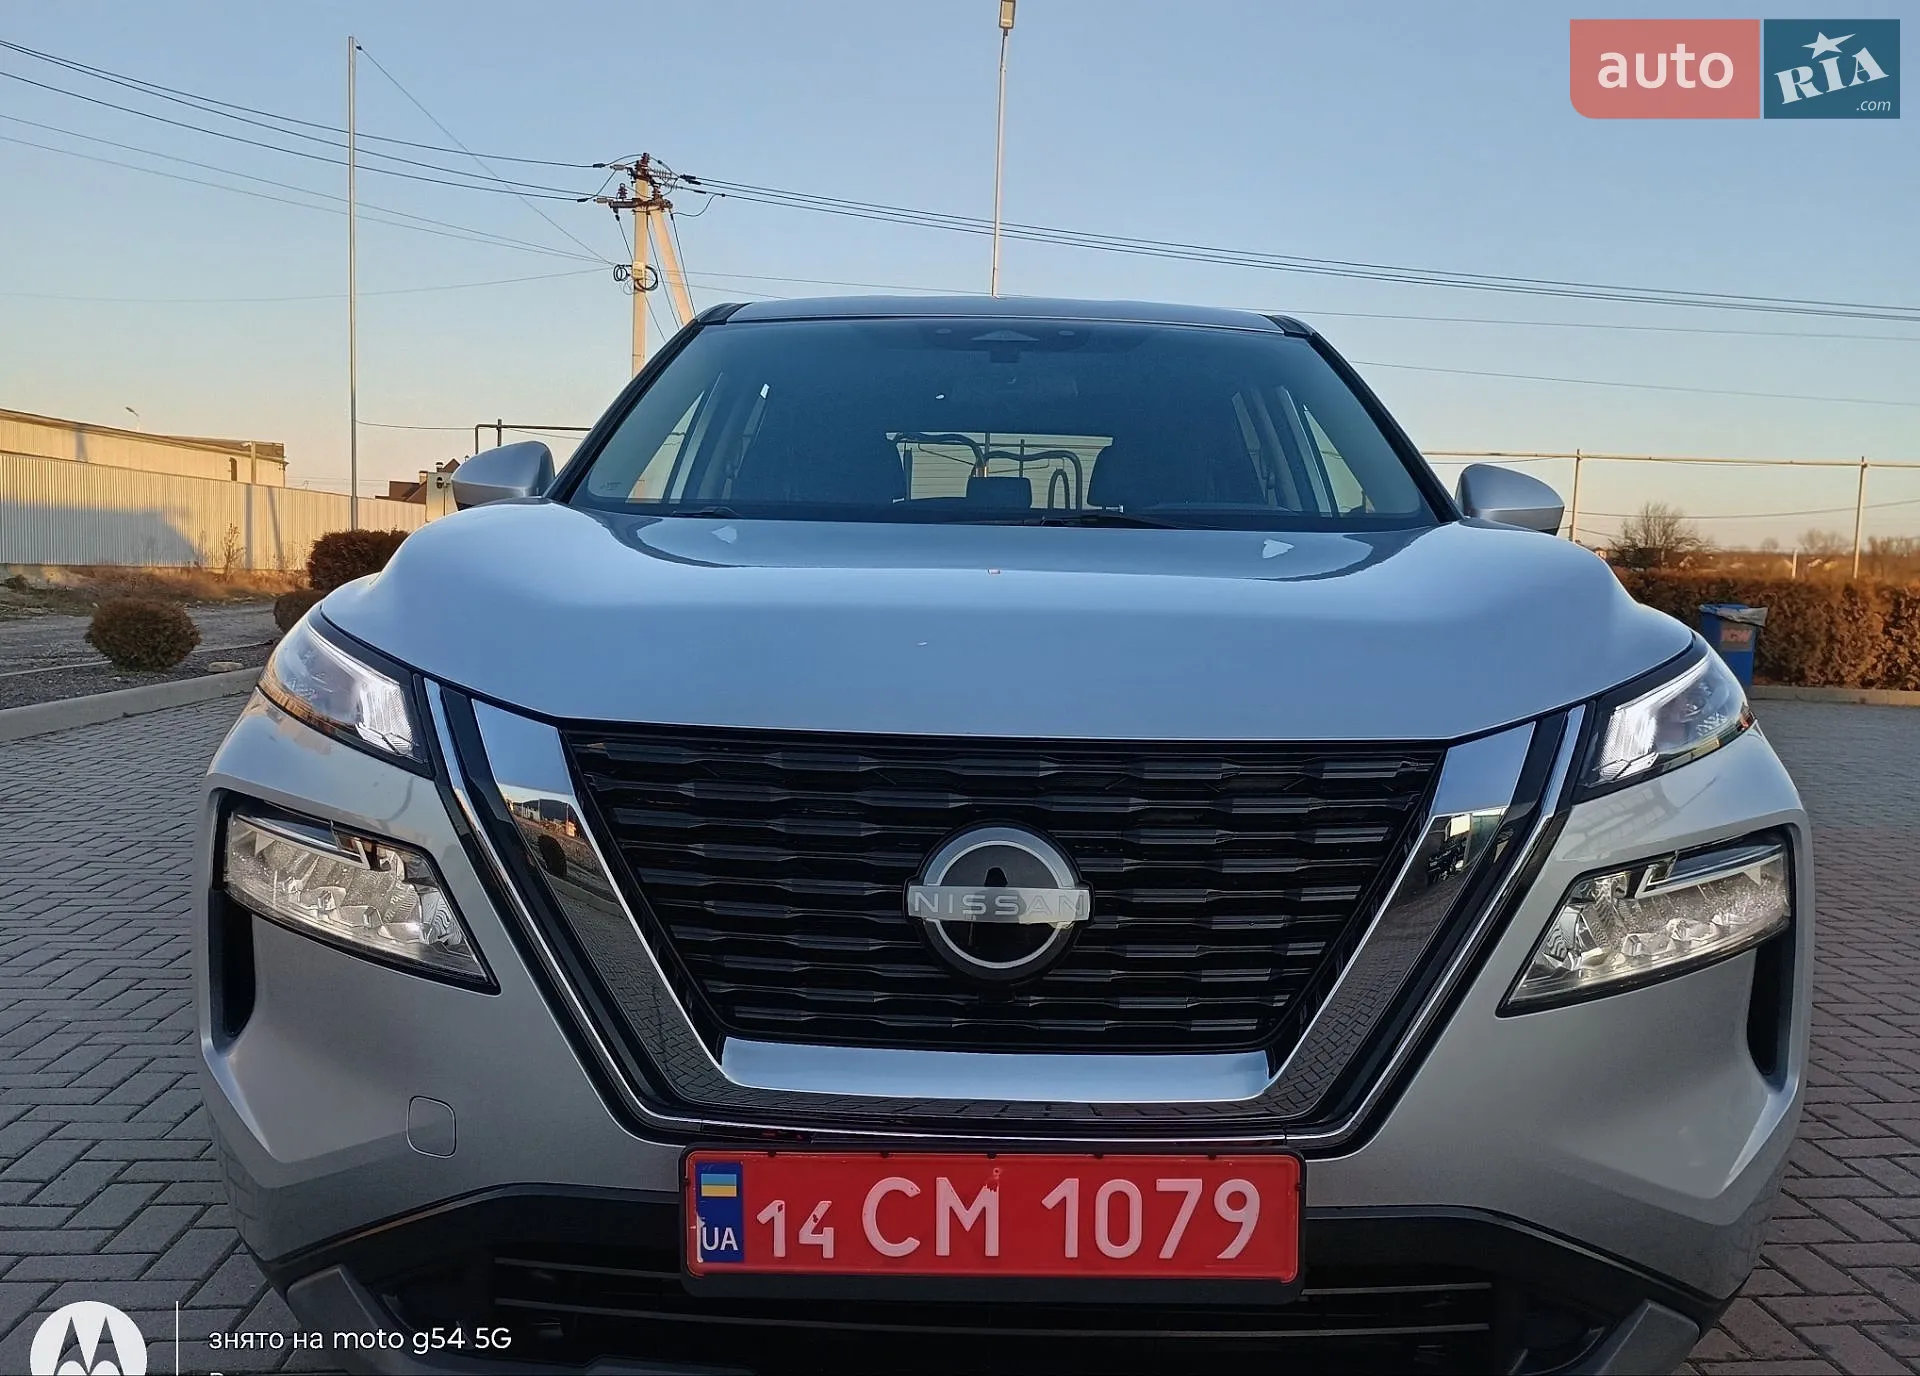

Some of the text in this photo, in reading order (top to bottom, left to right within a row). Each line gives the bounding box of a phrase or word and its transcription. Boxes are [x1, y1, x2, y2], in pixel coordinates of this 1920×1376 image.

[914, 891, 1084, 917] NISSAN
[757, 1176, 1261, 1260] 14 CM 1079
[702, 1226, 738, 1252] UA
